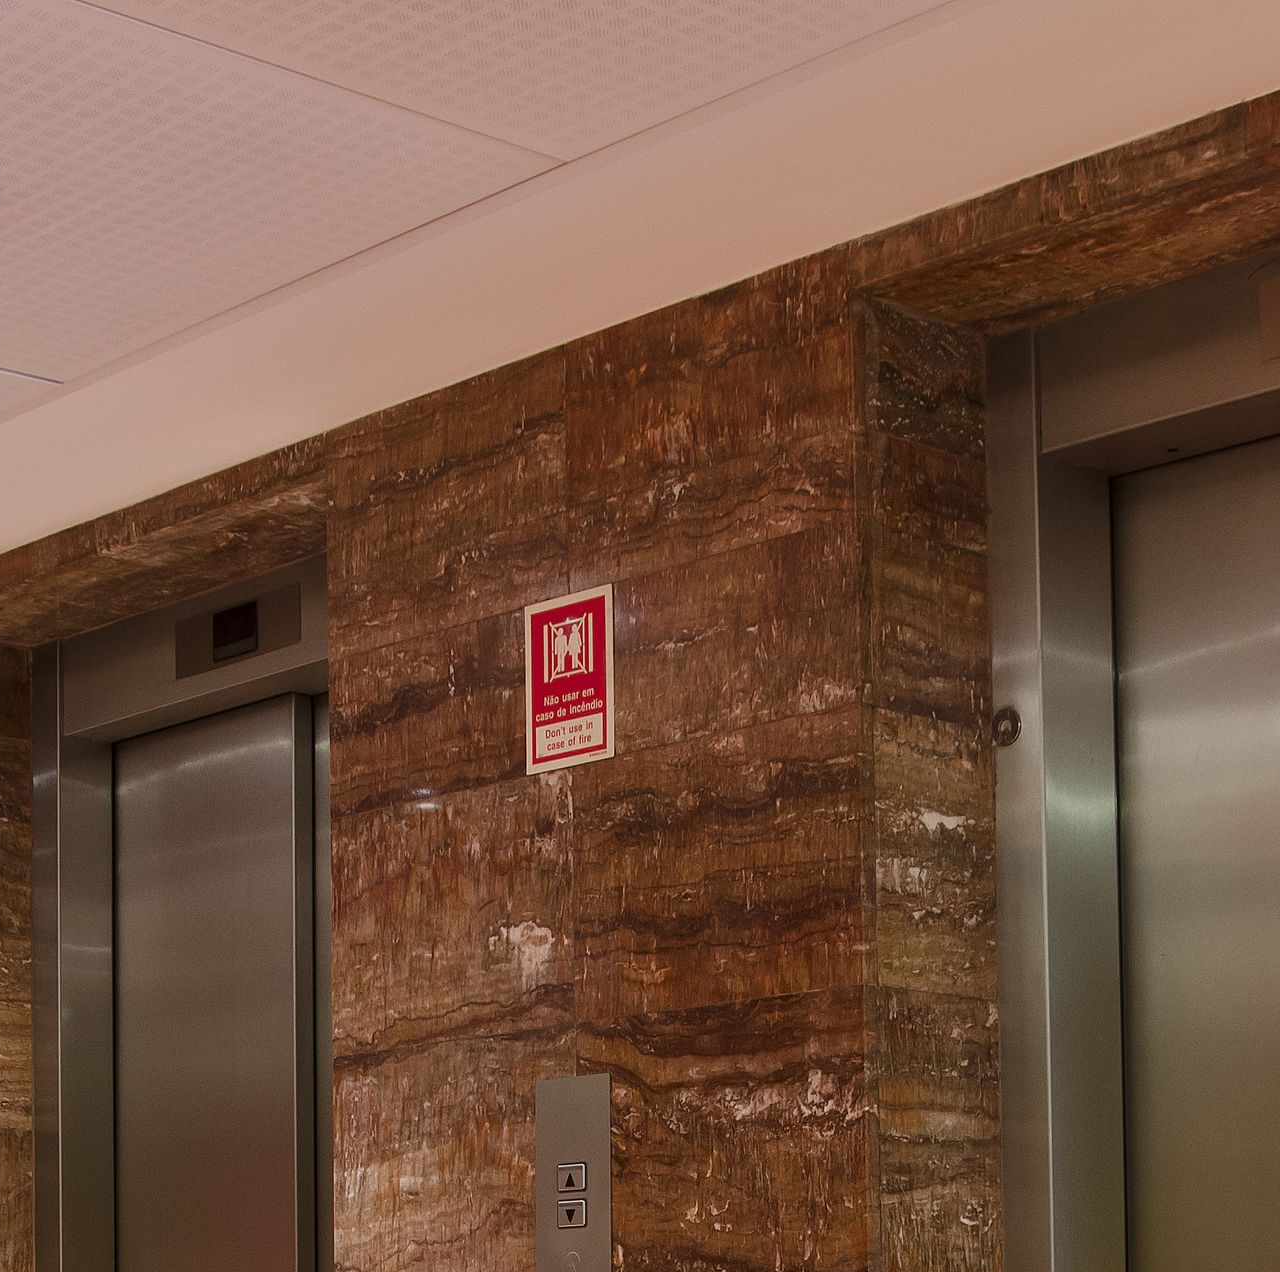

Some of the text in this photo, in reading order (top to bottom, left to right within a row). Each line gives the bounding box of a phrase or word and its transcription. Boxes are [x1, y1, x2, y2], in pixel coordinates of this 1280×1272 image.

[544, 687, 594, 706] Não usar em
[536, 699, 603, 722] caso de incêndio
[545, 720, 593, 739] Don't use in
[547, 734, 592, 751] case of fire
